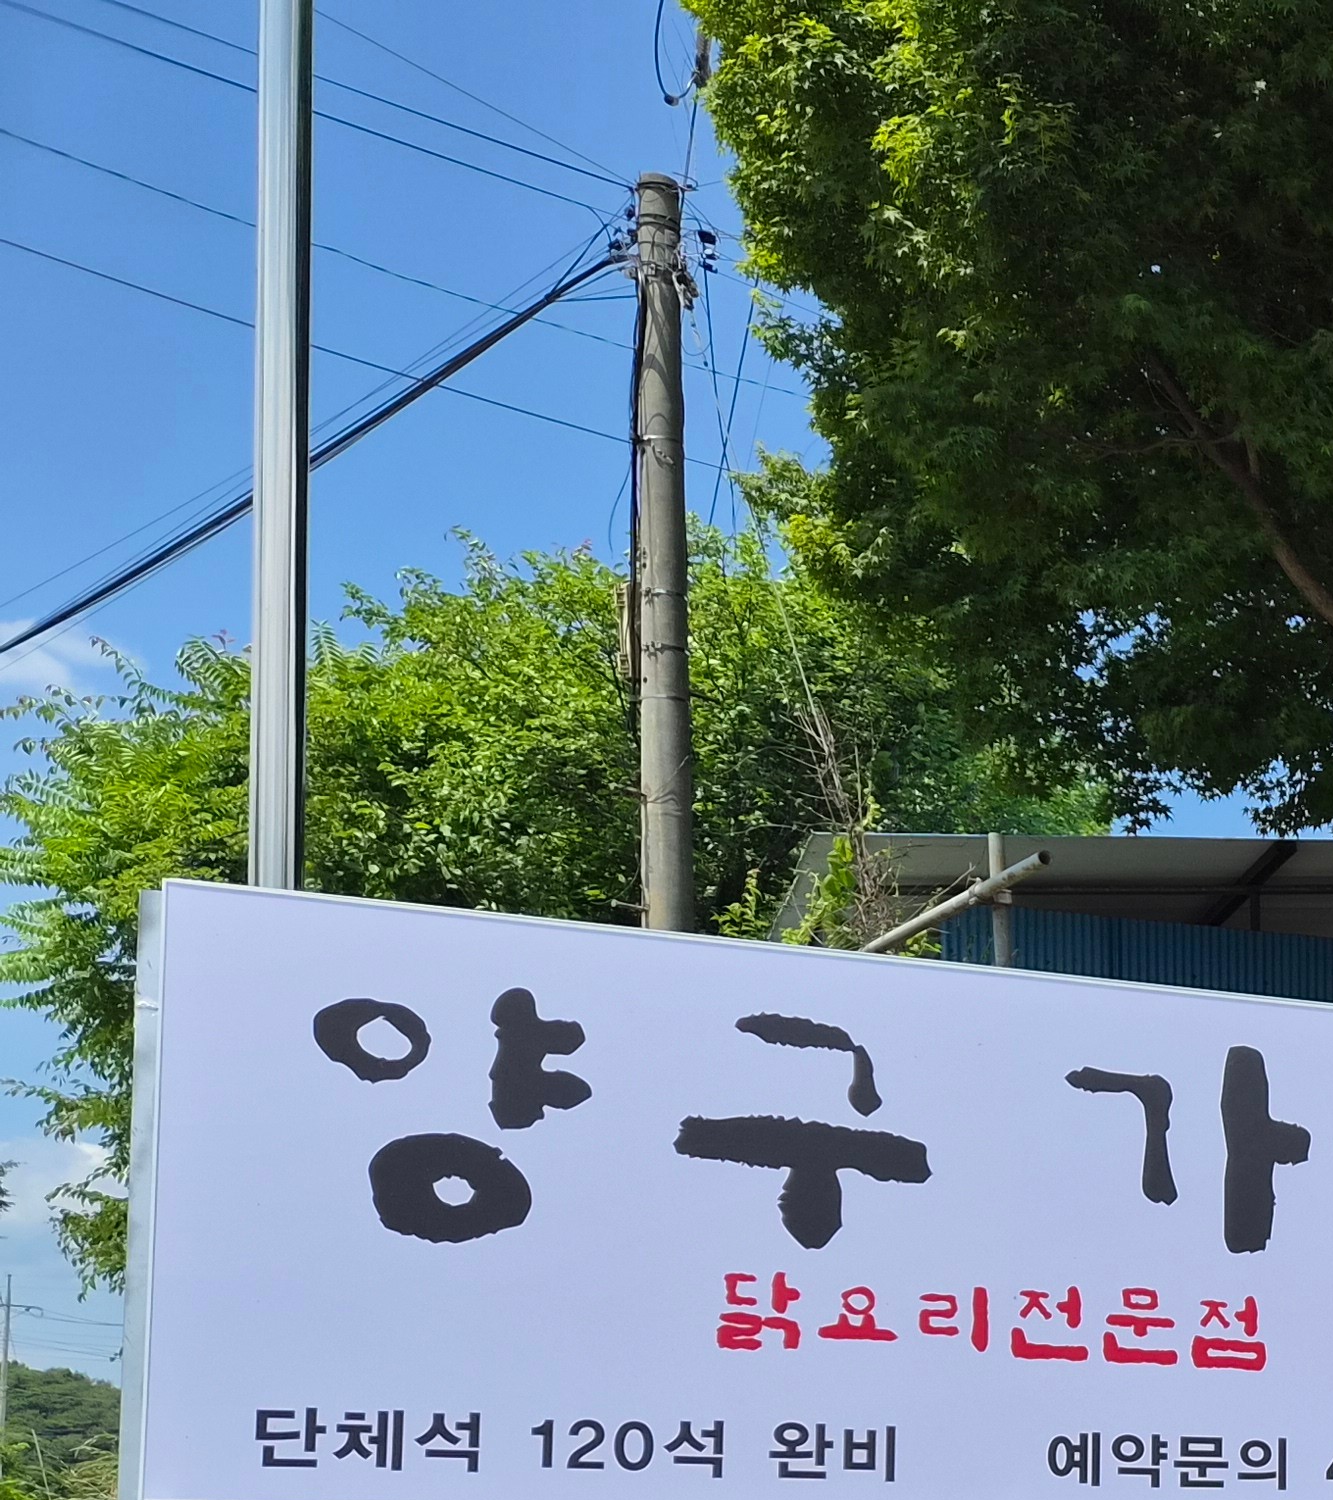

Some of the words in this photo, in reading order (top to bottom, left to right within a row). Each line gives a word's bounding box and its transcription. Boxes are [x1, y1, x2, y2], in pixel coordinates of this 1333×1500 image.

[313, 987, 933, 1250] 양구
[717, 1272, 1267, 1372] 닭요리전문점
[255, 1407, 481, 1473] 단체석
[531, 1419, 724, 1479] 120석
[769, 1422, 896, 1482] 완비
[1047, 1432, 1287, 1491] 예약문의
